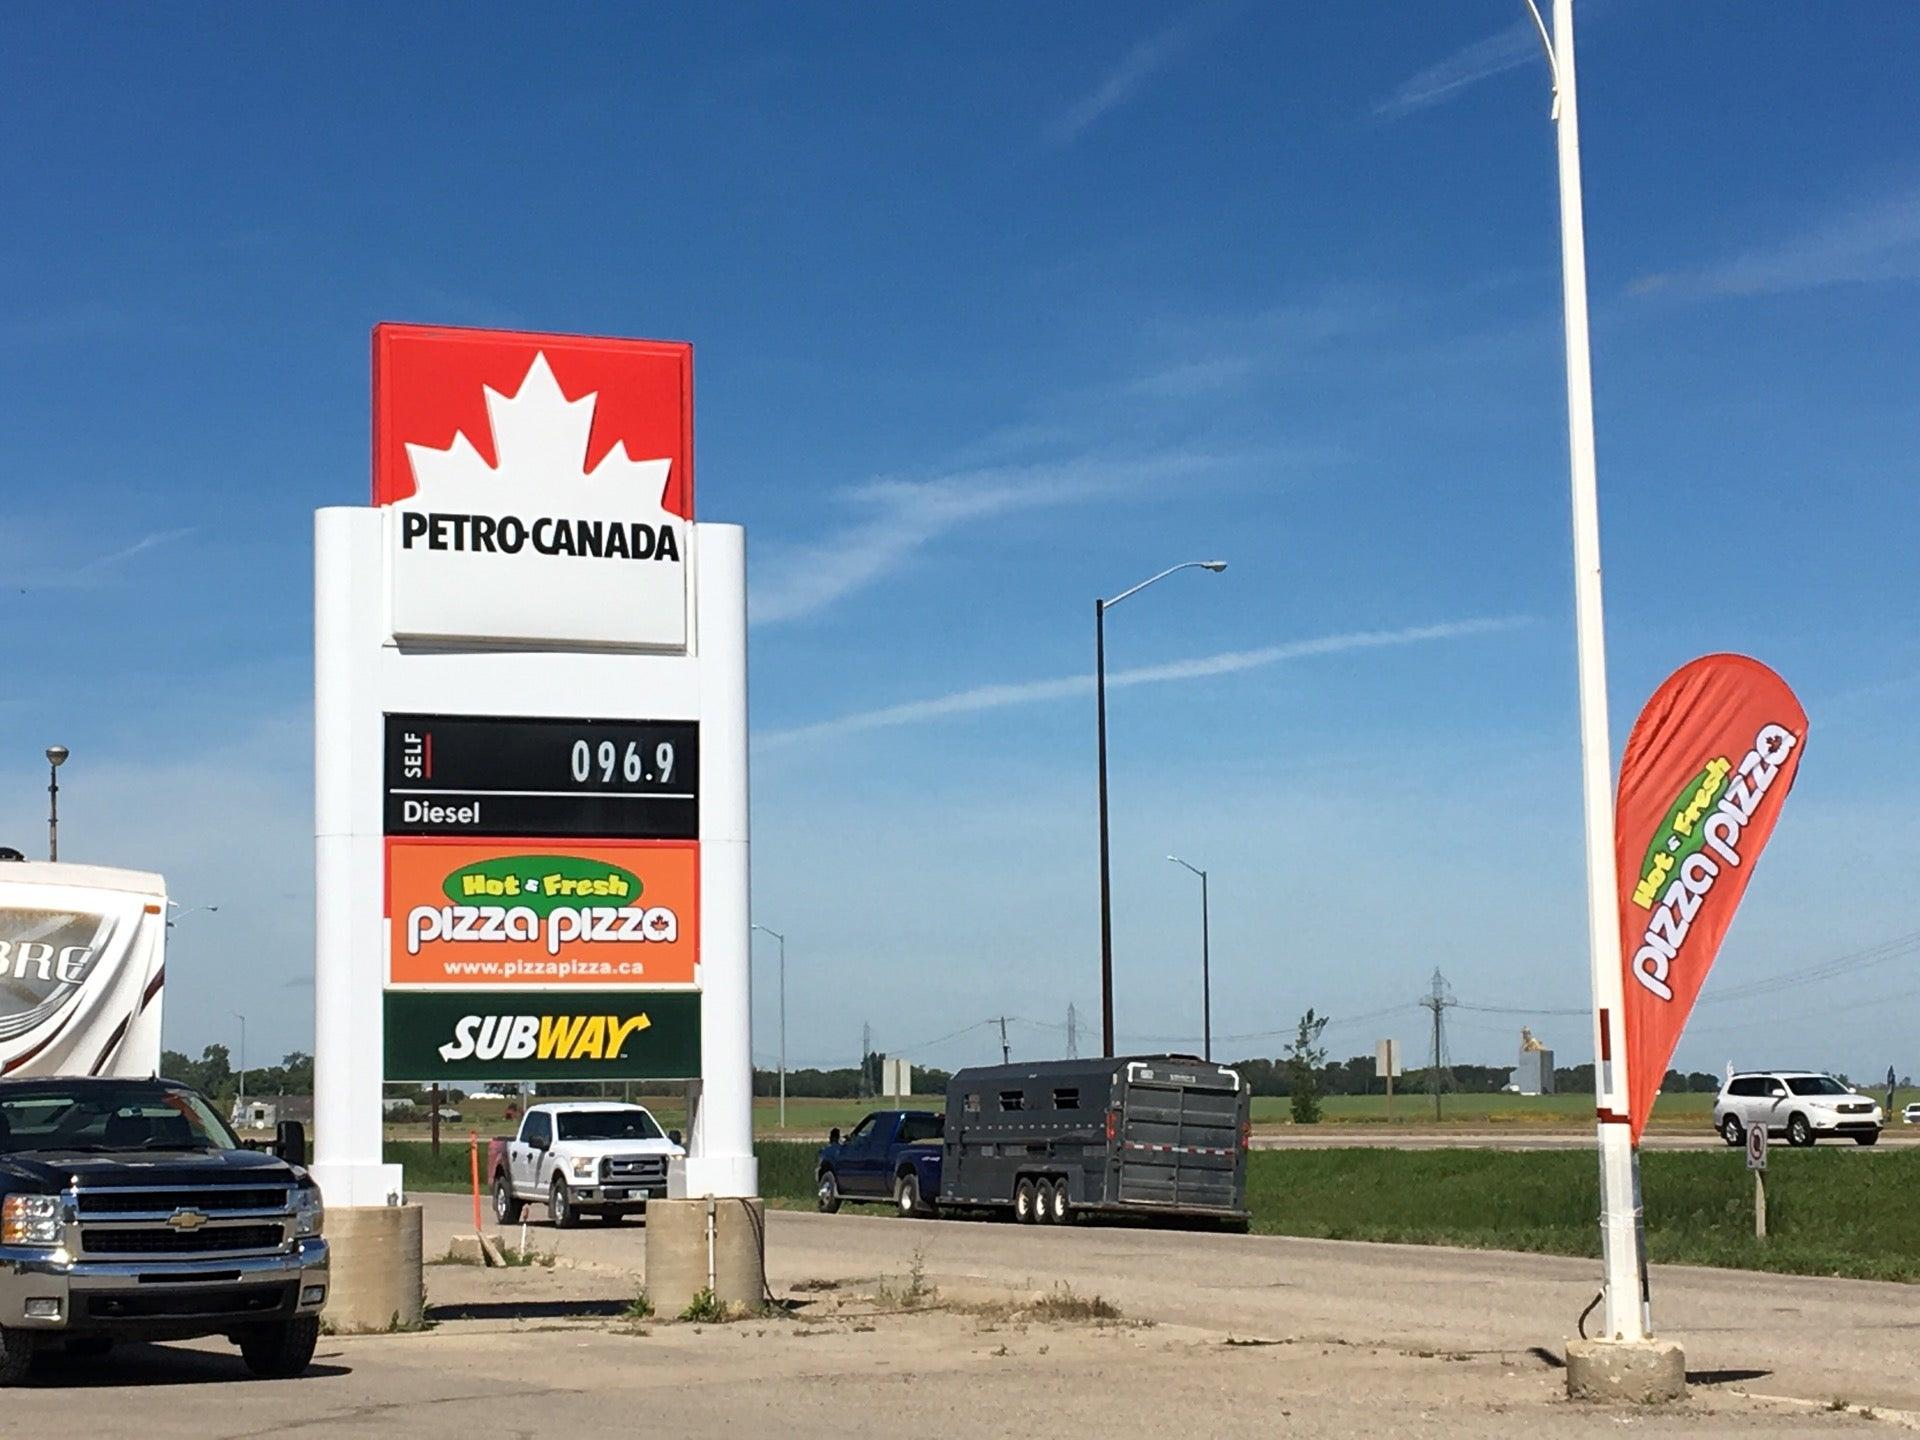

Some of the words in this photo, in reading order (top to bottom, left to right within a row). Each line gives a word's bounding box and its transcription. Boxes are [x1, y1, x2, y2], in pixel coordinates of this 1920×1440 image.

[404, 733, 421, 778] SELF
[571, 740, 675, 783] 096.9
[403, 801, 480, 824] Diesel
[1632, 852, 1674, 910] Hot
[1673, 757, 1732, 837] Fresh
[1632, 853, 1718, 1001] pizza
[1703, 723, 1797, 867] pizza
[462, 874, 520, 896] Hot
[525, 878, 539, 892] &
[543, 874, 629, 896] Fresh
[407, 905, 539, 956] pizza
[547, 906, 679, 956] pizza
[444, 959, 644, 978] www.pizzapizza.ca
[438, 1012, 652, 1063] SUBWAY
